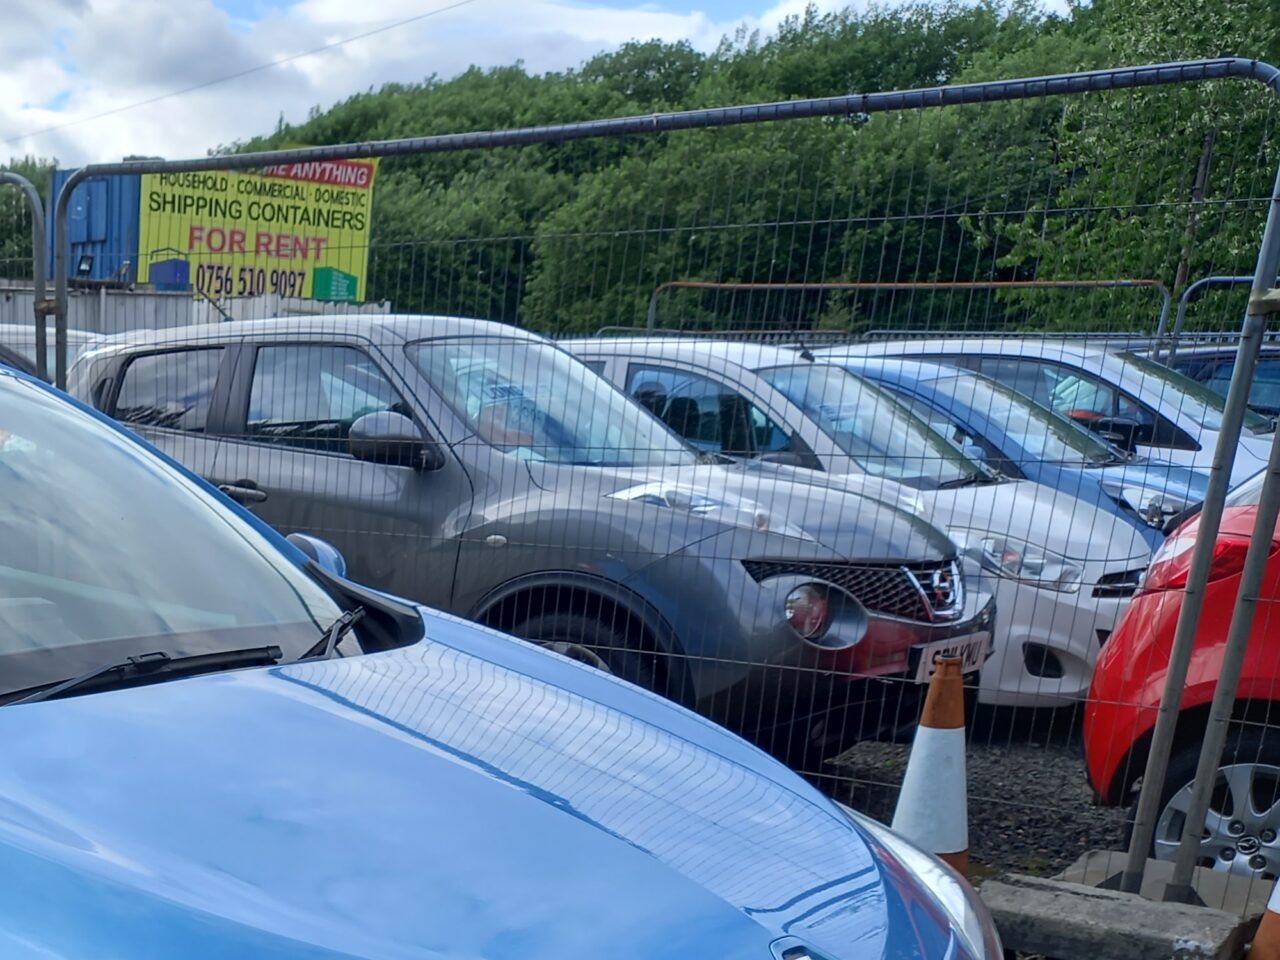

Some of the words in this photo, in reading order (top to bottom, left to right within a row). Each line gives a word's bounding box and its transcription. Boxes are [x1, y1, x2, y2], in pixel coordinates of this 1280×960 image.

[160, 173, 228, 193] HOUSEHOLD
[237, 179, 306, 201] COMMERCIAL
[314, 188, 366, 208] DOMESTIC
[290, 162, 368, 185] ANYTHING
[149, 192, 242, 220] SHIPPING
[248, 201, 365, 231] CONTAINERS
[189, 226, 246, 253] FOR
[255, 232, 328, 262] RENT
[196, 264, 233, 295] 0756
[238, 268, 266, 297] 510
[270, 270, 306, 298] 9097
